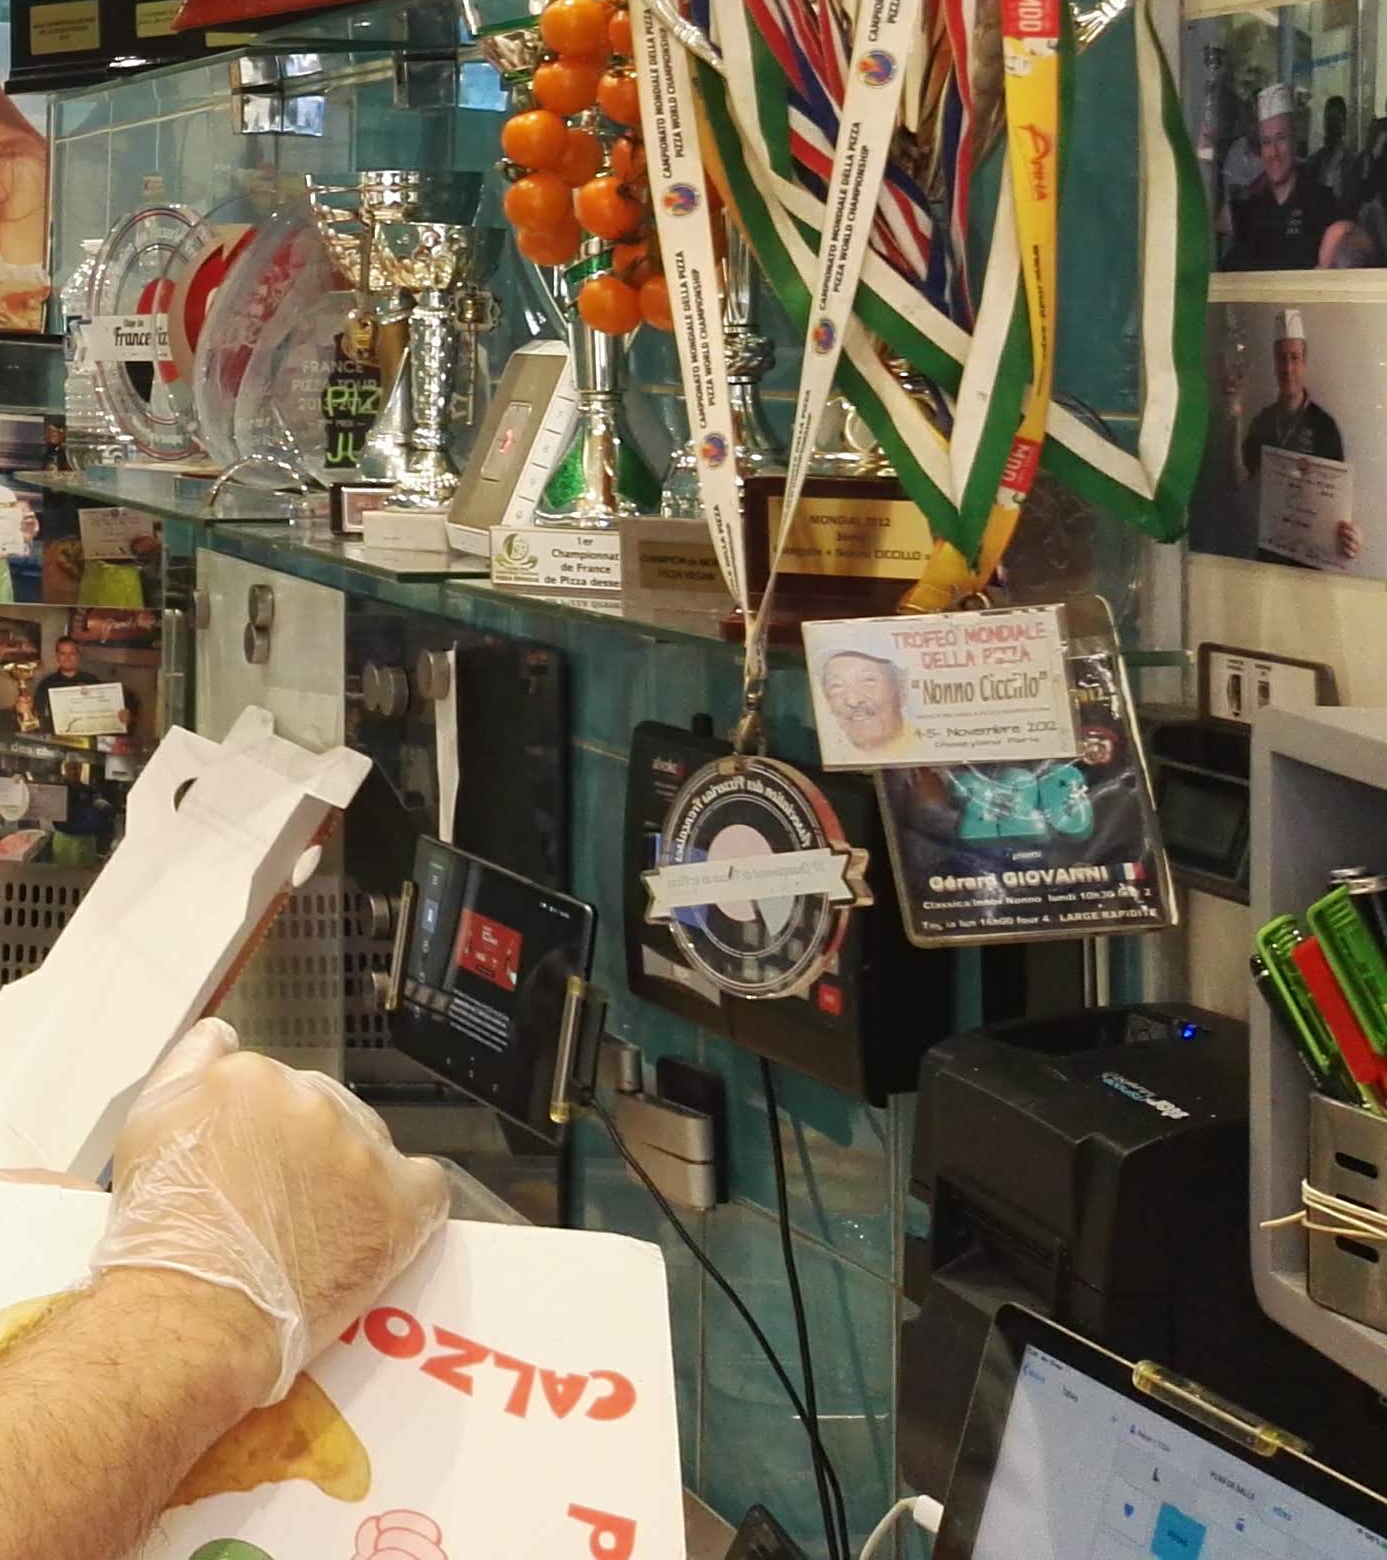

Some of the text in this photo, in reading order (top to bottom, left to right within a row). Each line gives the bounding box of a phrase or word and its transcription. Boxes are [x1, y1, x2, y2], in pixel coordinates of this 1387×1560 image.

[643, 8, 672, 179] CAMPIONATO MONDIALE DELLA PIZZA
[659, 27, 685, 158] PIZZA WORLD CHAMPIONSHIP
[819, 121, 861, 311] CAMPIONATO MONDIALE DELLA PIZZA
[832, 144, 869, 293] PIZZA WORLD CHAMPIONSHIP
[114, 327, 151, 346] France
[674, 250, 707, 429] CAMPIONATO MONDIALE DELLA PIZZA
[690, 268, 716, 407] PIZZA WORLD CHAMPIONSHIP
[302, 360, 364, 373] FRANCE
[577, 536, 593, 545] 1er
[551, 549, 619, 561] Championnat
[561, 564, 611, 574] de France
[560, 577, 587, 586] Pizza
[891, 622, 1046, 650] TROFEO MONDIALE
[921, 649, 975, 670] DELLA
[928, 865, 1108, 892] Gérard GIOVANNI
[1059, 911, 1099, 922] LARGE
